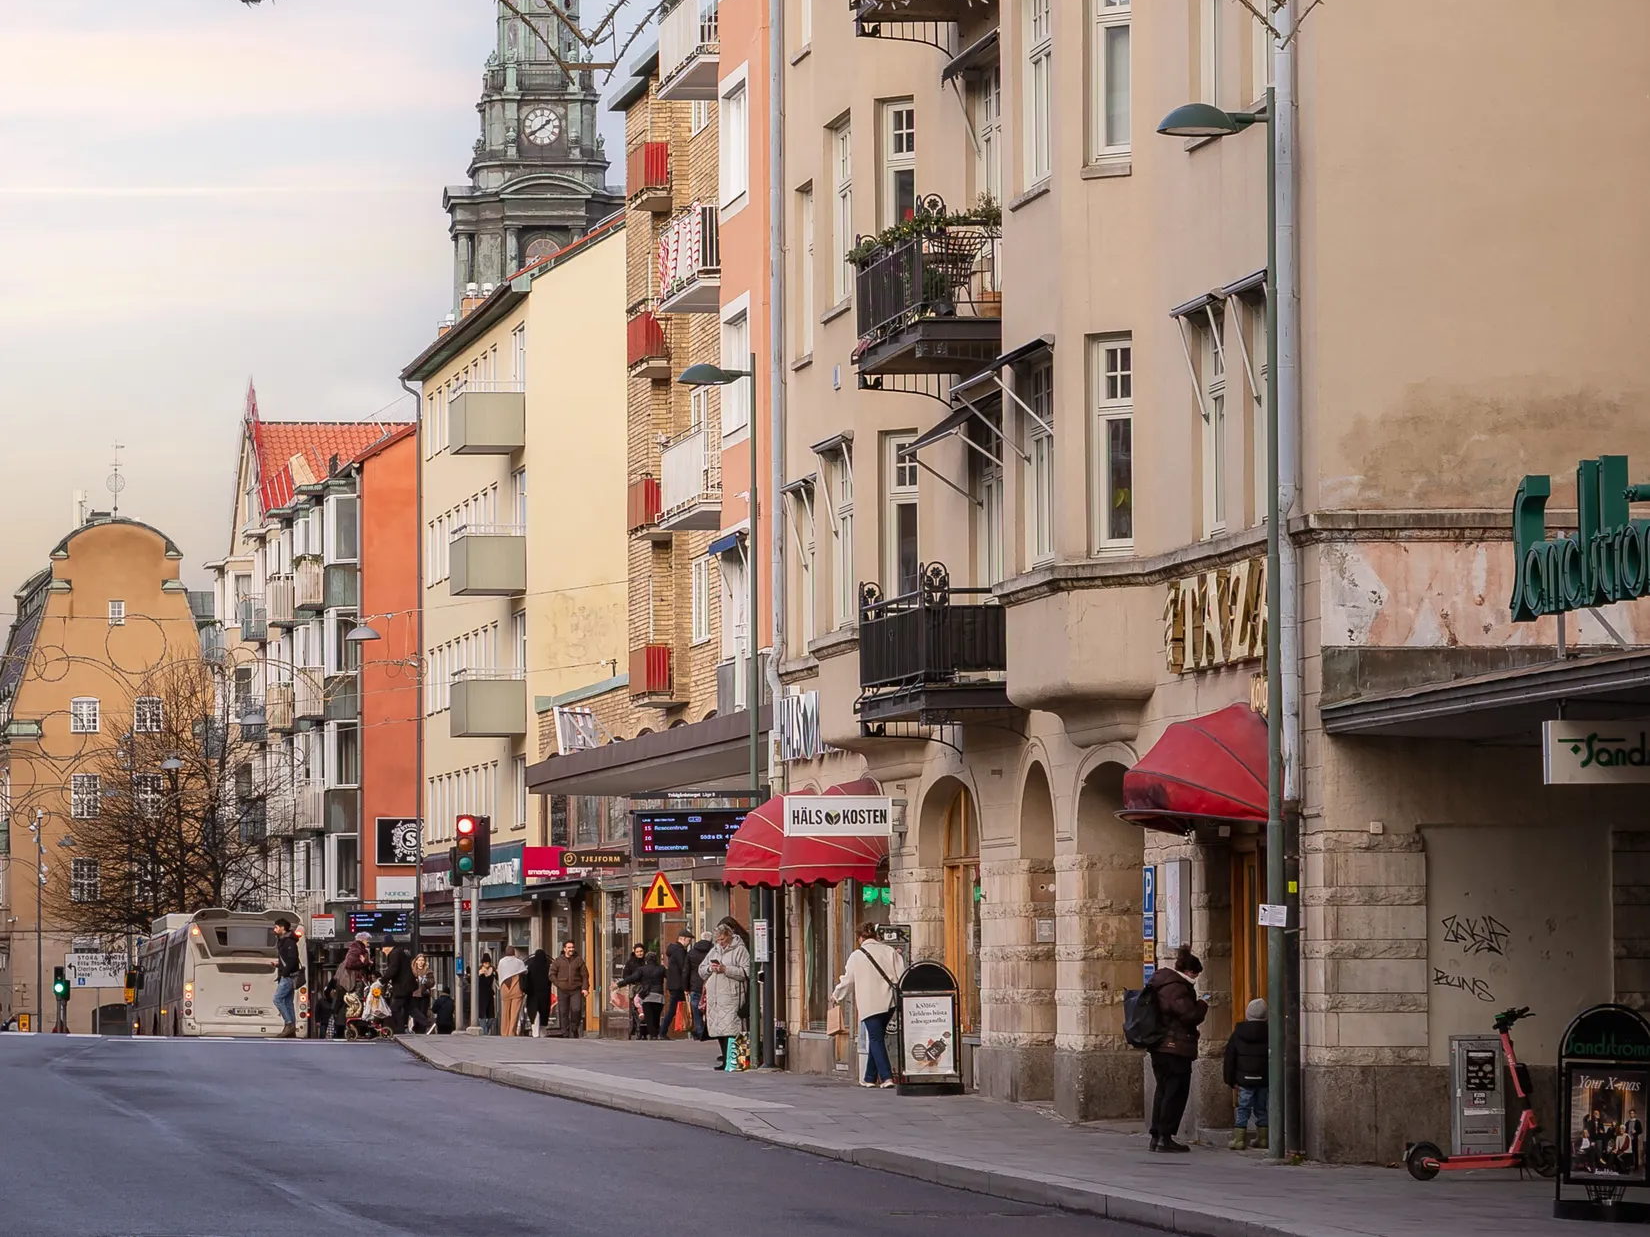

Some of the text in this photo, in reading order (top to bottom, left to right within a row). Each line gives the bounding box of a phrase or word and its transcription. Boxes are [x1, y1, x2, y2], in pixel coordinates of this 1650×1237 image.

[1580, 732, 1650, 768] Sand
[792, 807, 887, 825] HÄLS KOSTEN
[1145, 871, 1152, 909] P
[1578, 1075, 1642, 1092] Your X-mas
